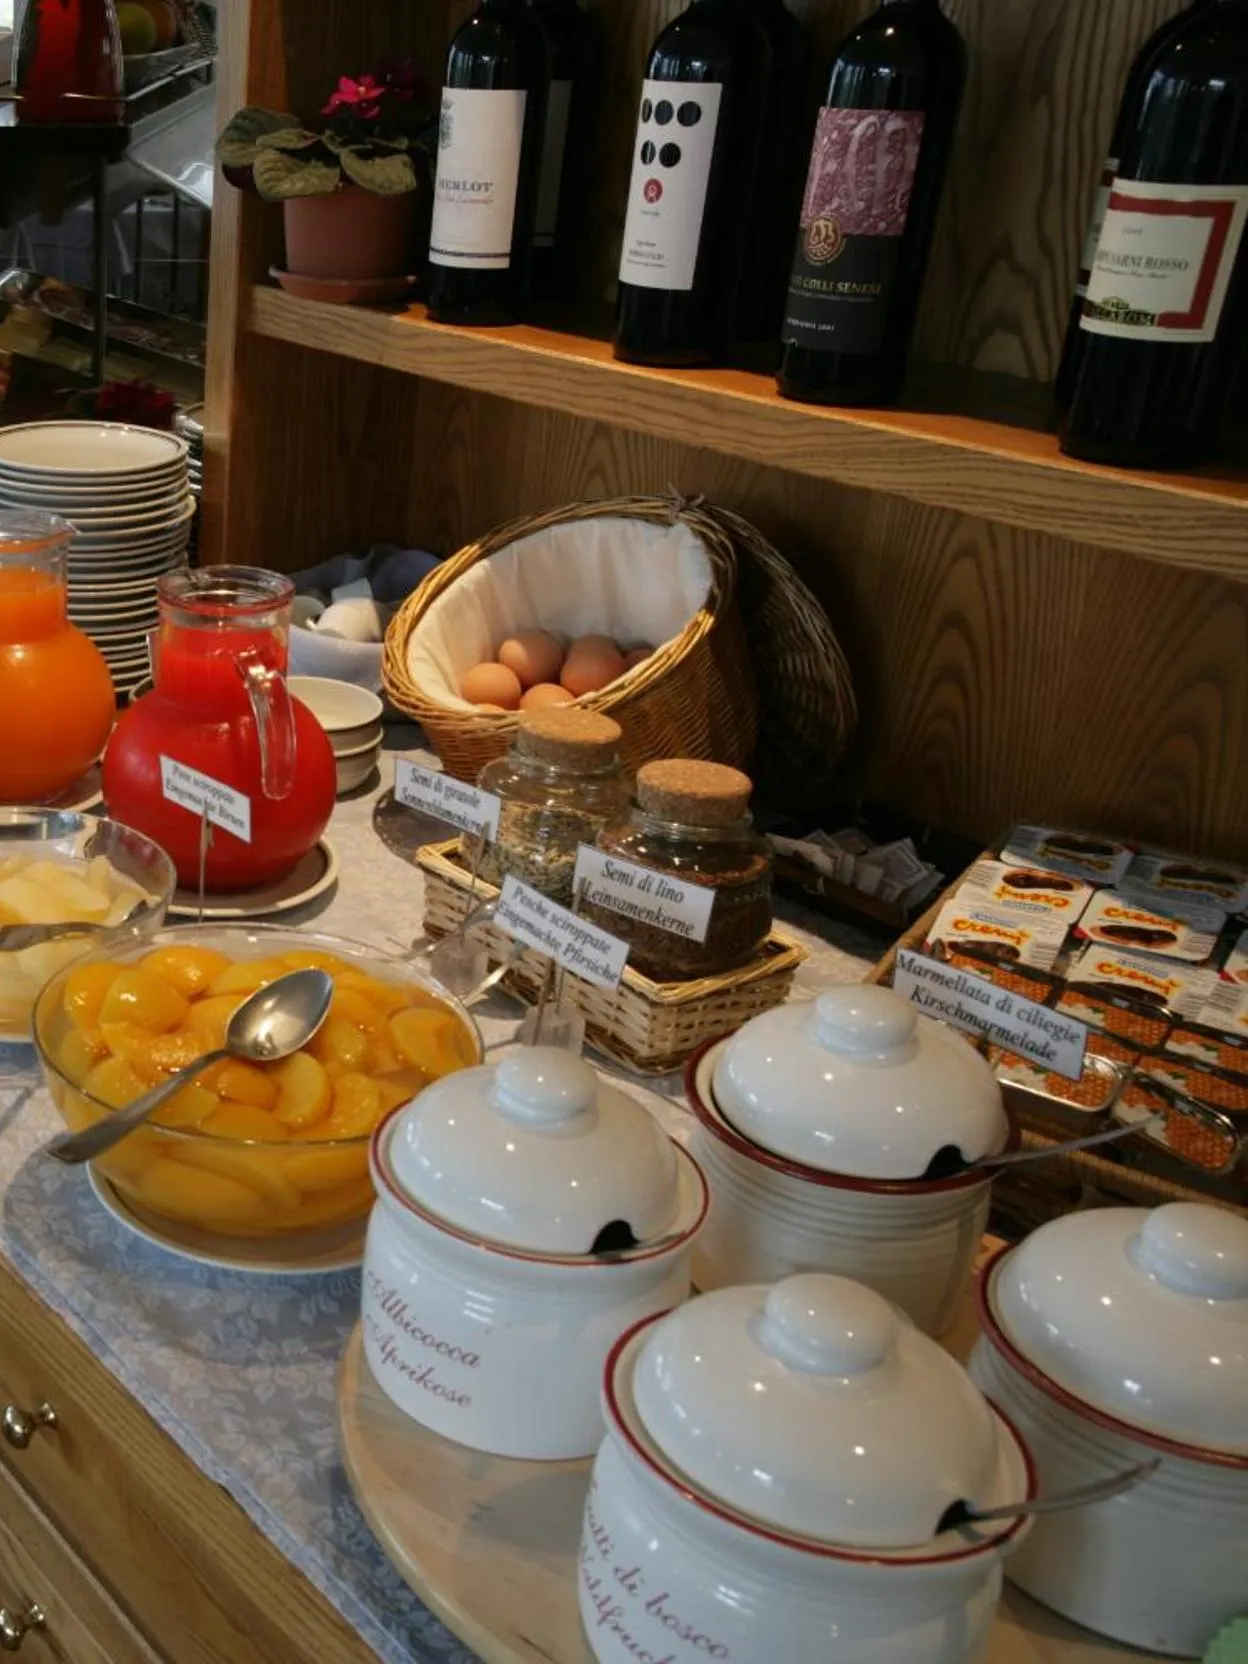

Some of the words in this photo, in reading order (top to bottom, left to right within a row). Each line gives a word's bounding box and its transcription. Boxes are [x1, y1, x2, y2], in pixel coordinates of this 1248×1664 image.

[410, 767, 433, 789] Semi
[582, 878, 695, 937] Leinsamenkerne
[601, 859, 633, 887] Semi
[636, 873, 654, 894] di
[654, 877, 685, 905] lino
[494, 900, 562, 952] Eingemachte
[562, 943, 619, 983] Pfirsiche
[513, 885, 550, 919] Pesche
[550, 912, 612, 955] sciroppate
[899, 952, 993, 1004] Marmellata
[994, 992, 1013, 1016] di
[1015, 1004, 1081, 1046] ciliegie
[910, 983, 1059, 1063] Kirschmarmelade
[613, 1566, 645, 1597] di
[644, 1591, 730, 1660] bosco
